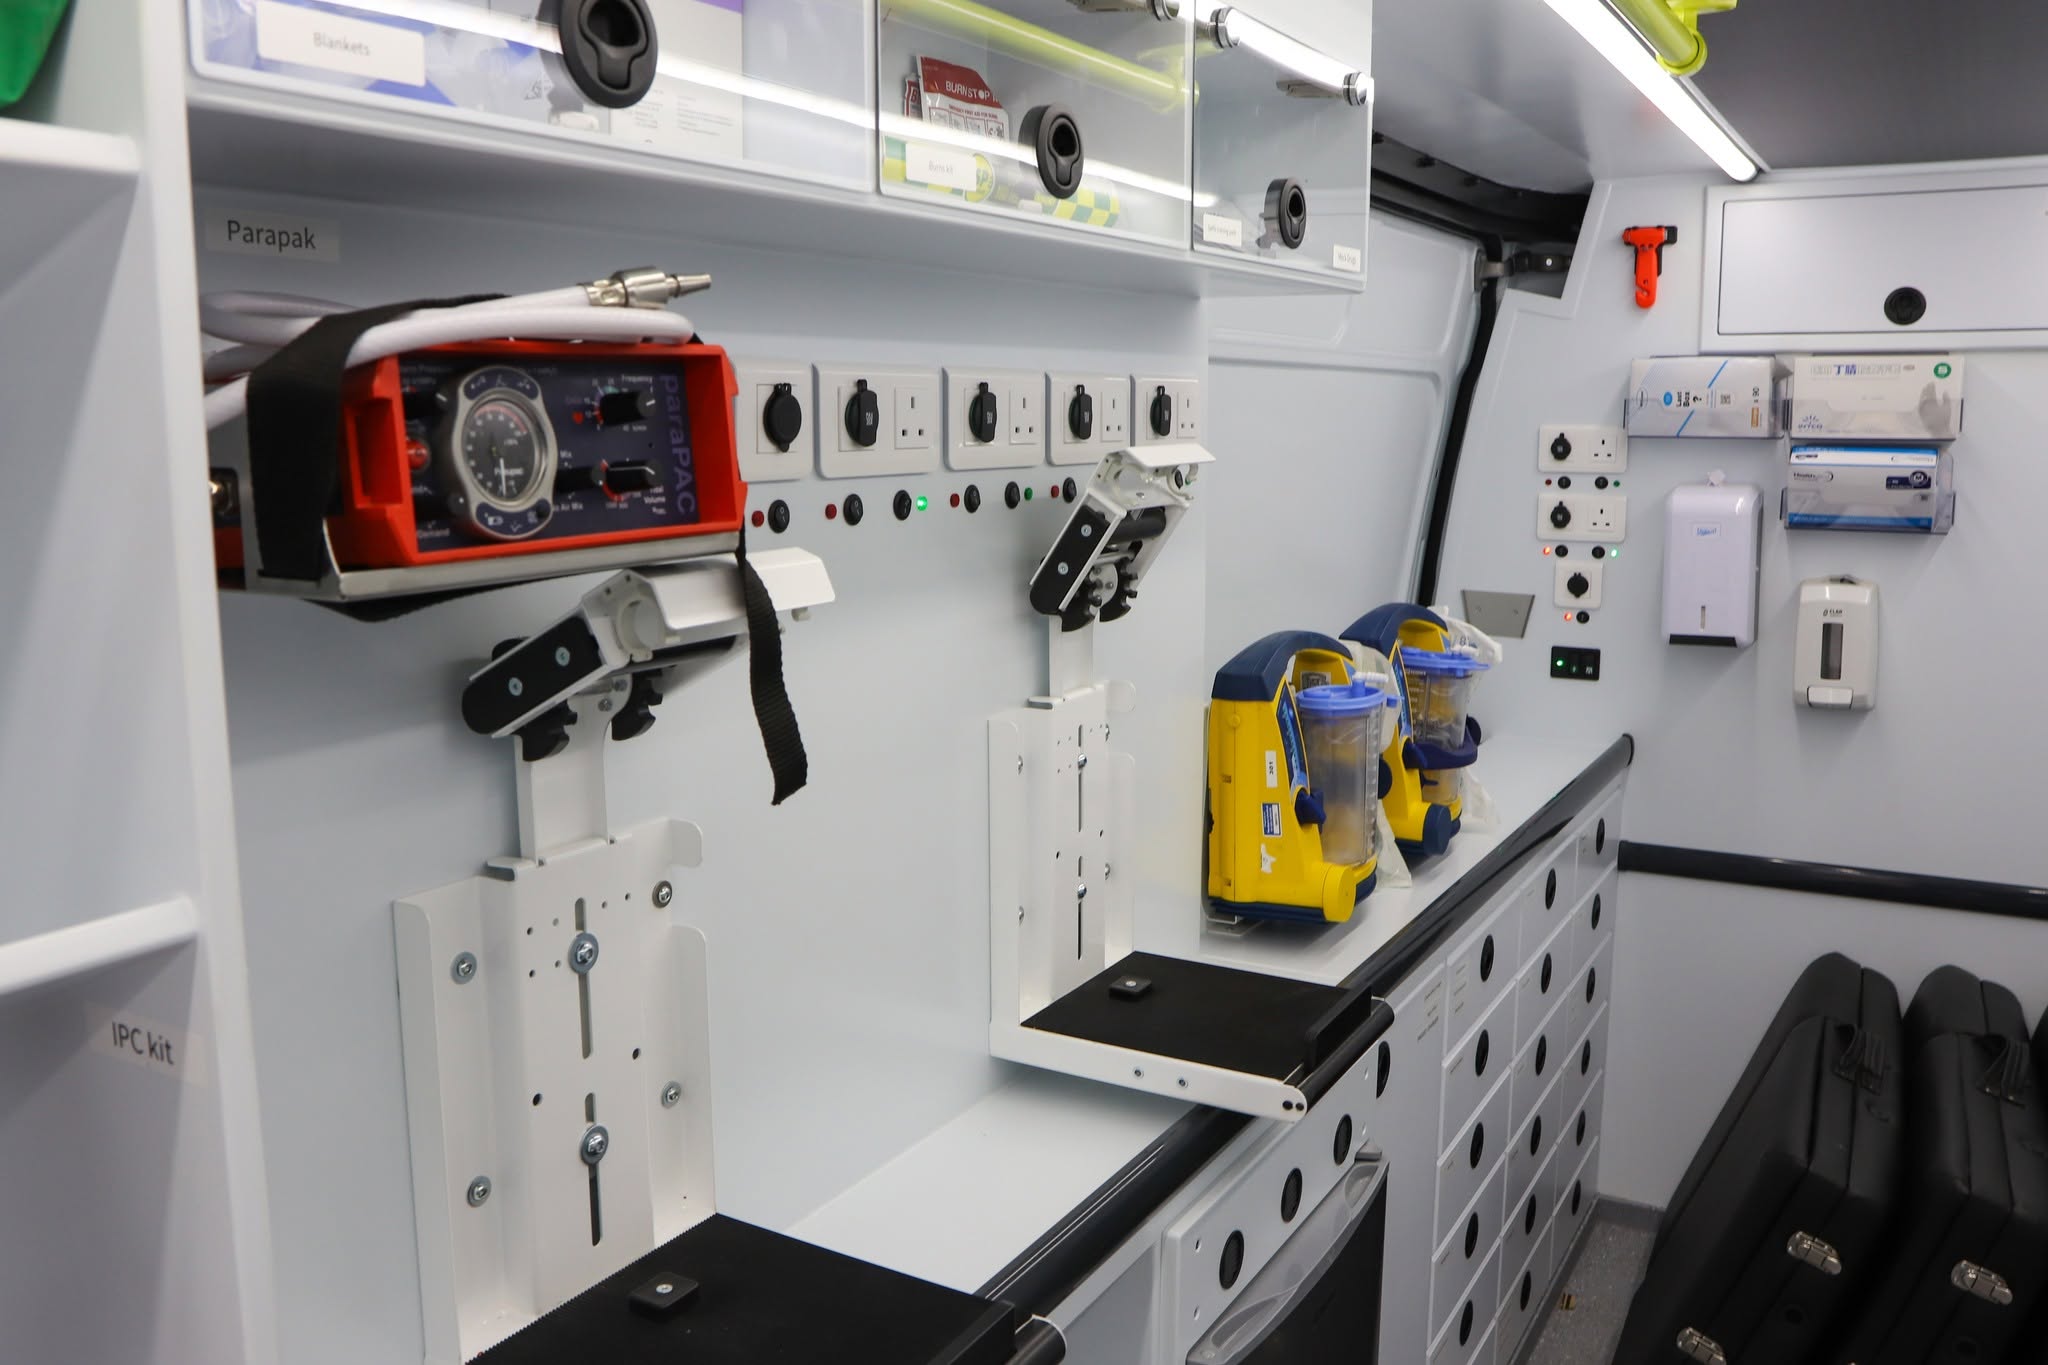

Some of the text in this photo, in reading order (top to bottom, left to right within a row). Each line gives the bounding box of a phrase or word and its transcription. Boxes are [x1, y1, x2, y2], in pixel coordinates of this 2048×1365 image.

[312, 31, 371, 56] Blankets
[945, 80, 991, 100] BURNSTOP
[227, 219, 316, 253] Parapak
[660, 375, 696, 515] paraPAC
[111, 1021, 174, 1066] IPC kit
